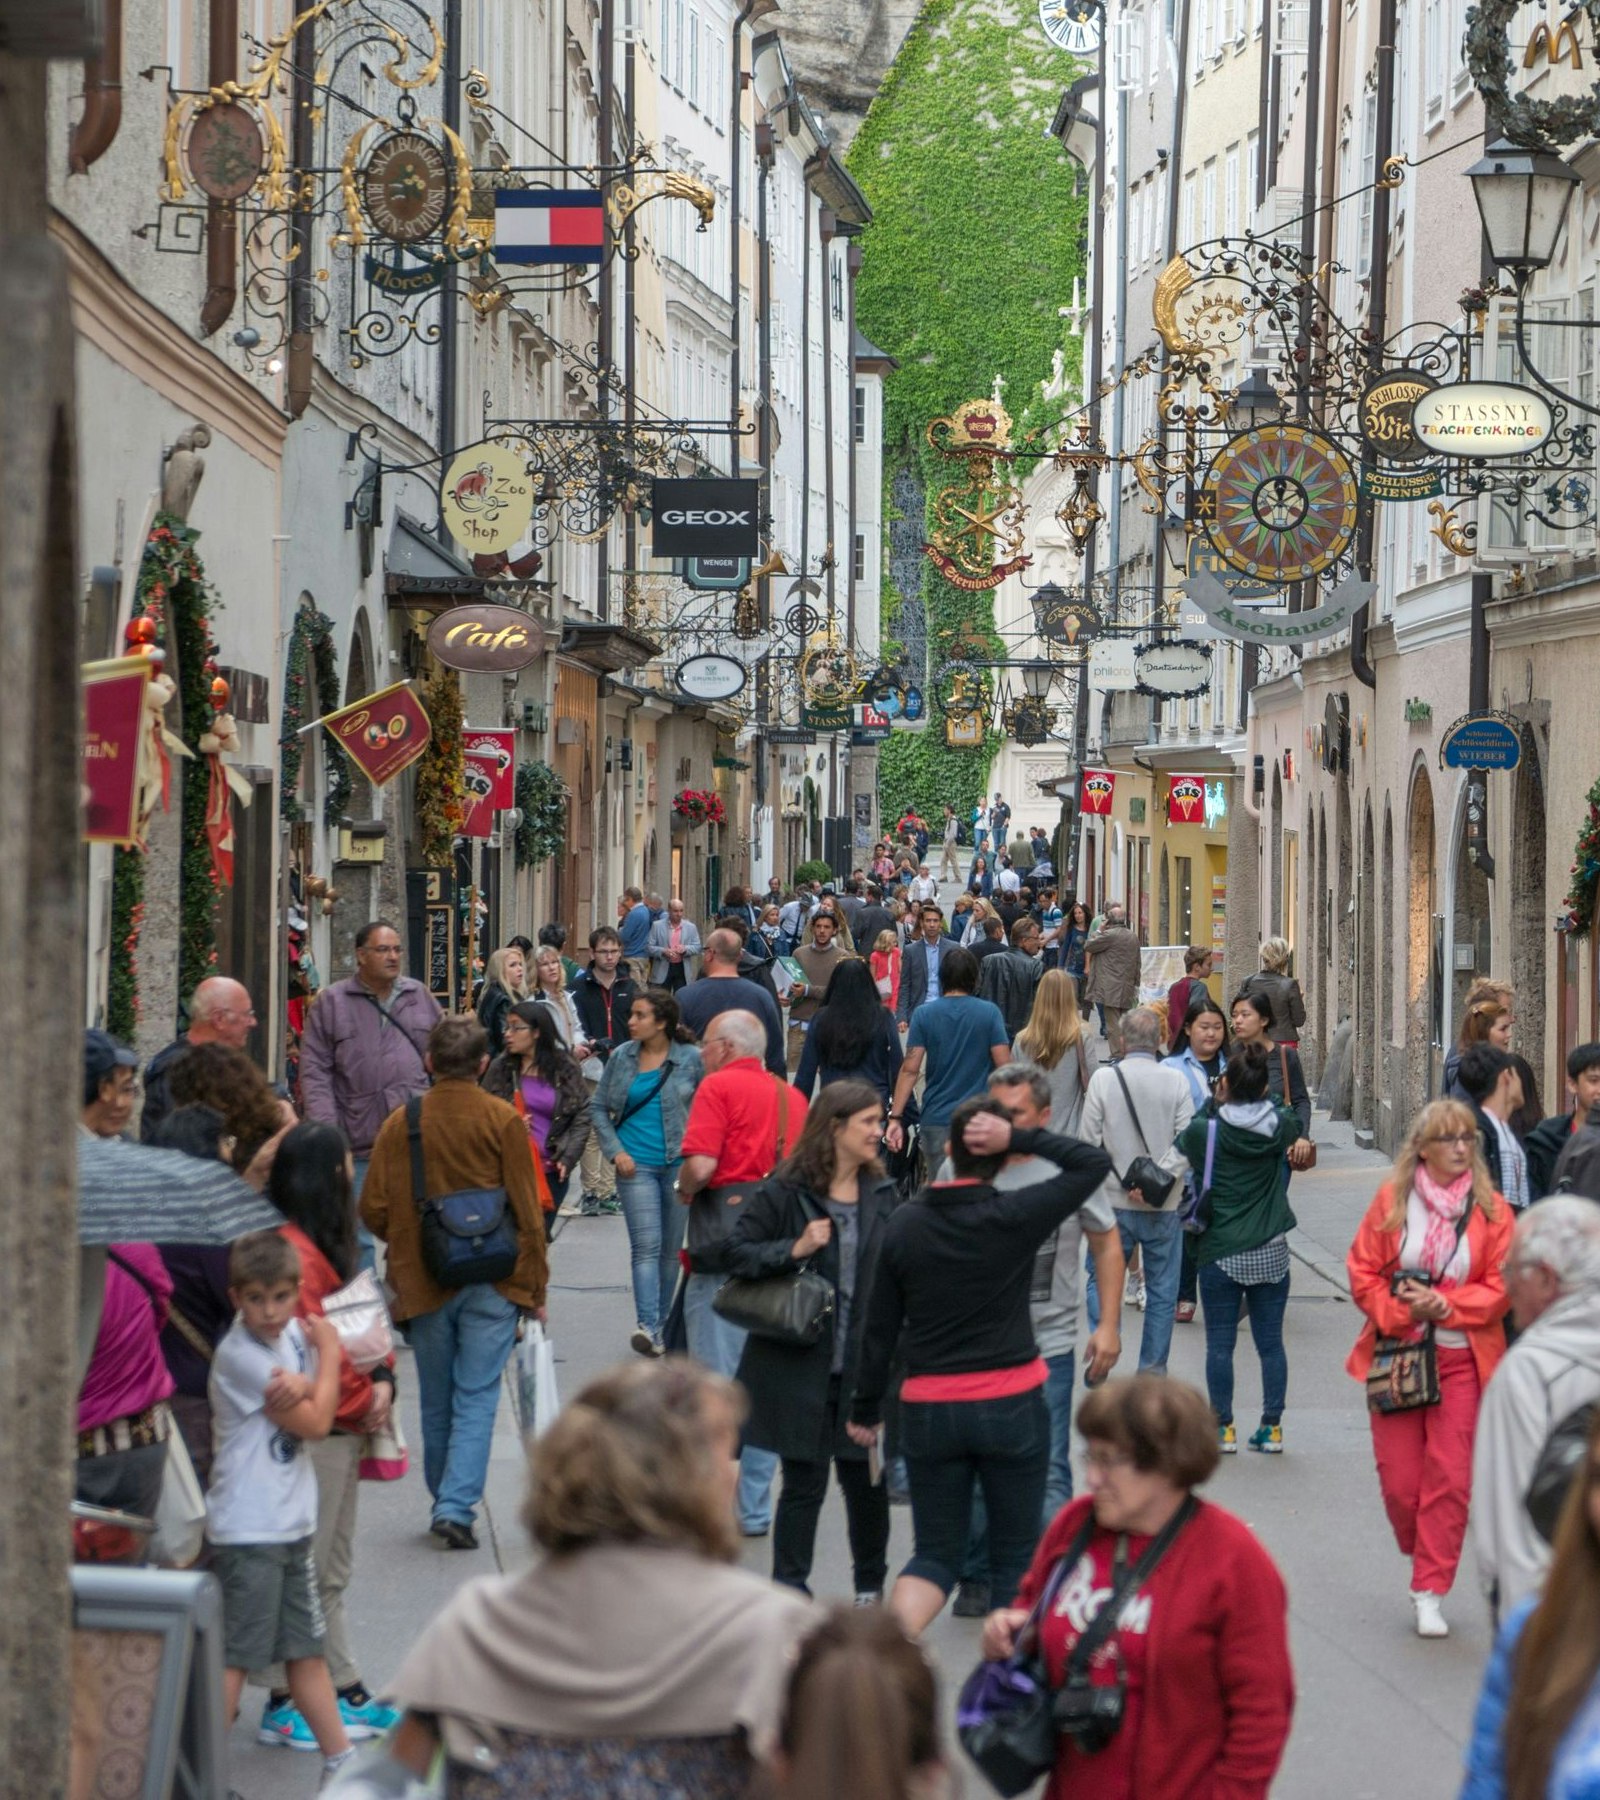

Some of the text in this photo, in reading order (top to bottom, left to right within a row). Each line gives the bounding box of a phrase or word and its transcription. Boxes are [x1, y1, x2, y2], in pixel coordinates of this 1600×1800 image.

[368, 135, 445, 178] SALZBURGER
[1433, 403, 1533, 422] STASSNY
[1364, 411, 1414, 441] Wie
[494, 477, 527, 496] Zoo
[1370, 483, 1432, 498] DIENST
[661, 509, 750, 526] GEOX
[462, 520, 500, 544] Shop
[702, 558, 734, 568] WENGER
[1214, 606, 1347, 638] Aschauer
[444, 622, 529, 653] Café
[807, 714, 851, 727] STASSNY
[1451, 738, 1514, 748] Schlüsseldienst
[1458, 750, 1507, 761] WIEBER
[1087, 780, 1112, 793] EIS
[1174, 785, 1202, 798] EIS
